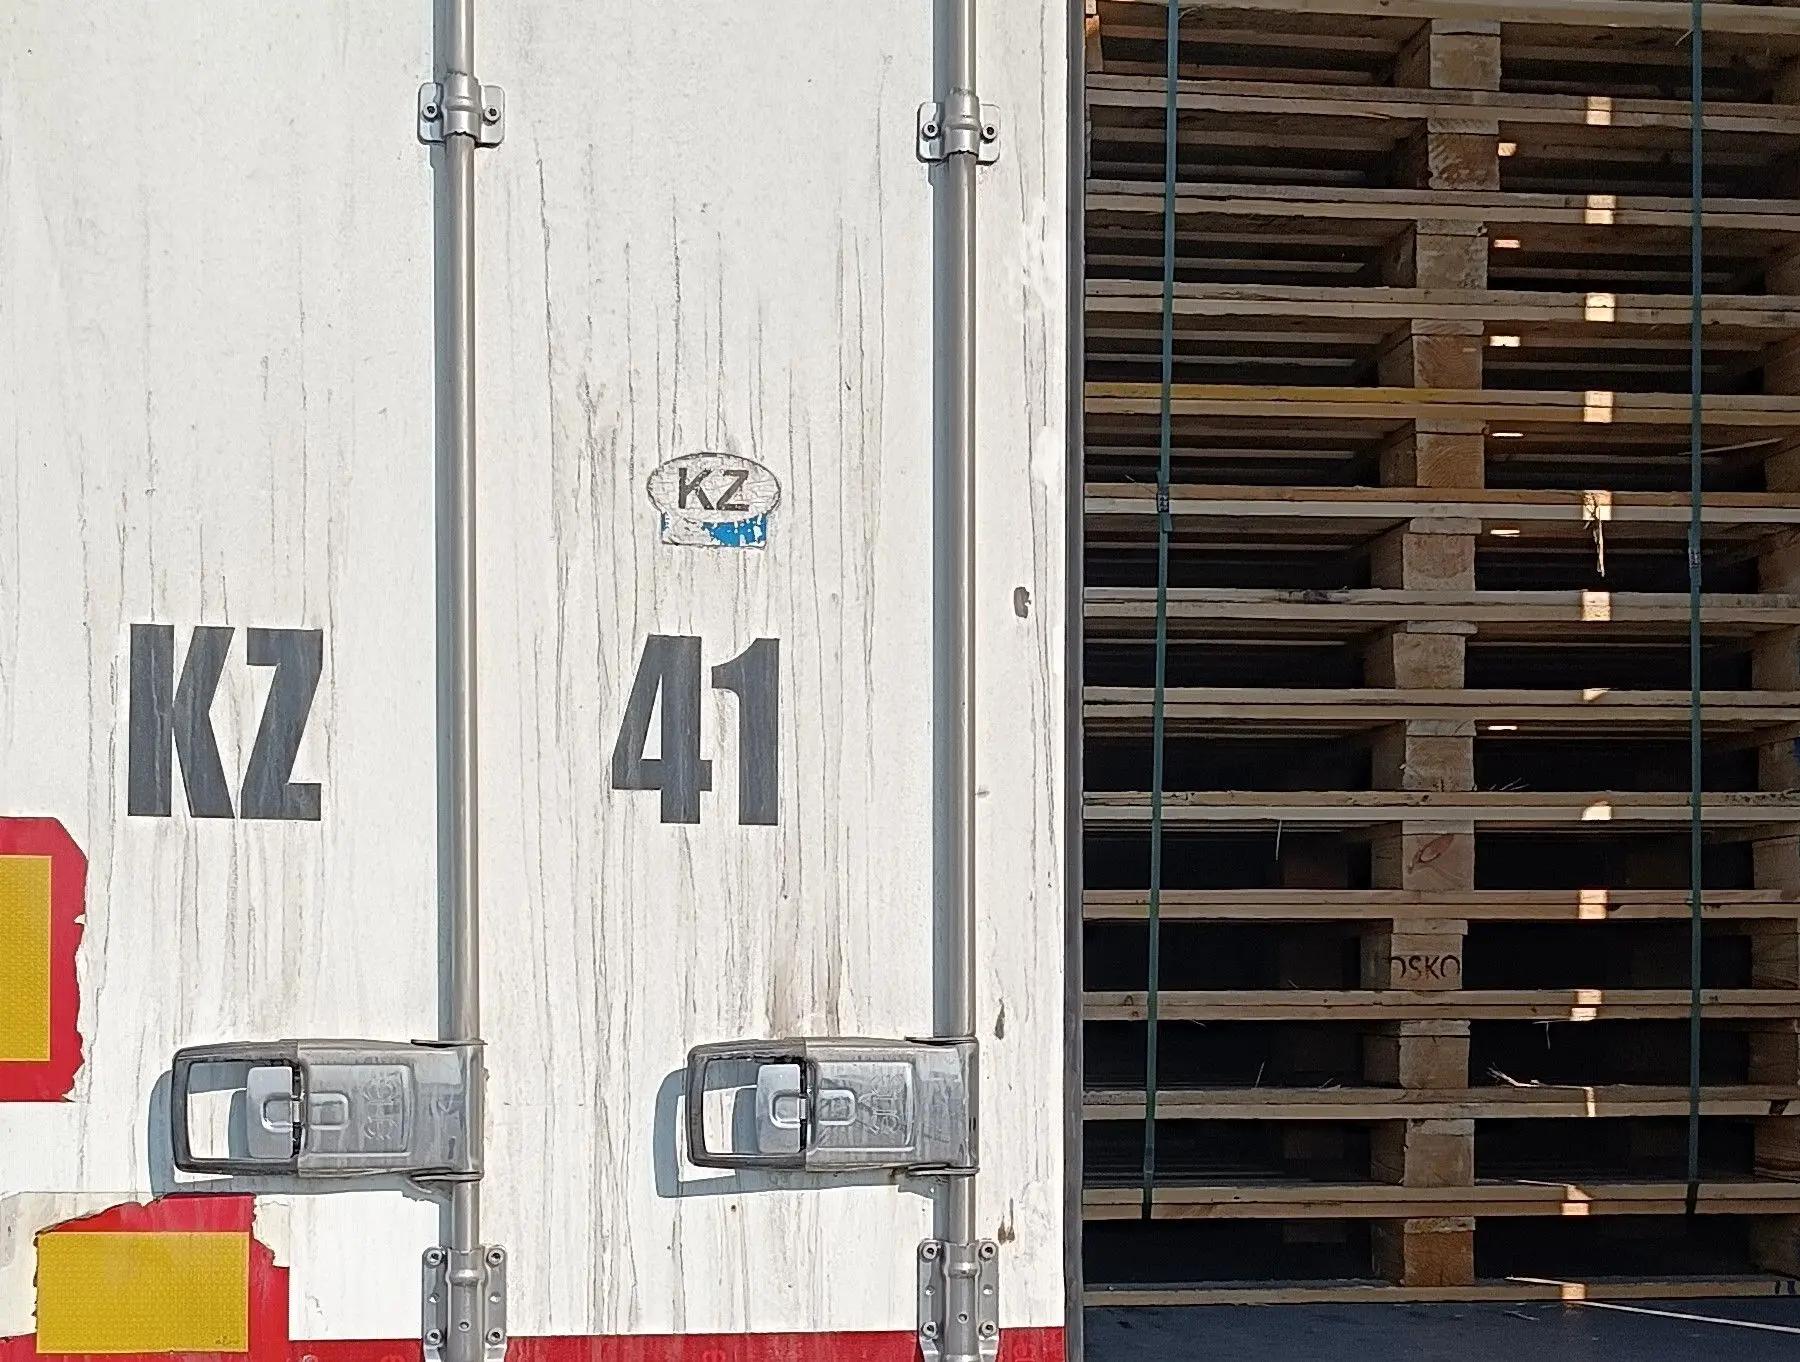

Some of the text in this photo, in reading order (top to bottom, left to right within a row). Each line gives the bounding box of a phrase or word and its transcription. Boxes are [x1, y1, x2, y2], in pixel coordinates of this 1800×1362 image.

[678, 467, 749, 512] KZ
[128, 624, 780, 826] KZ 41
